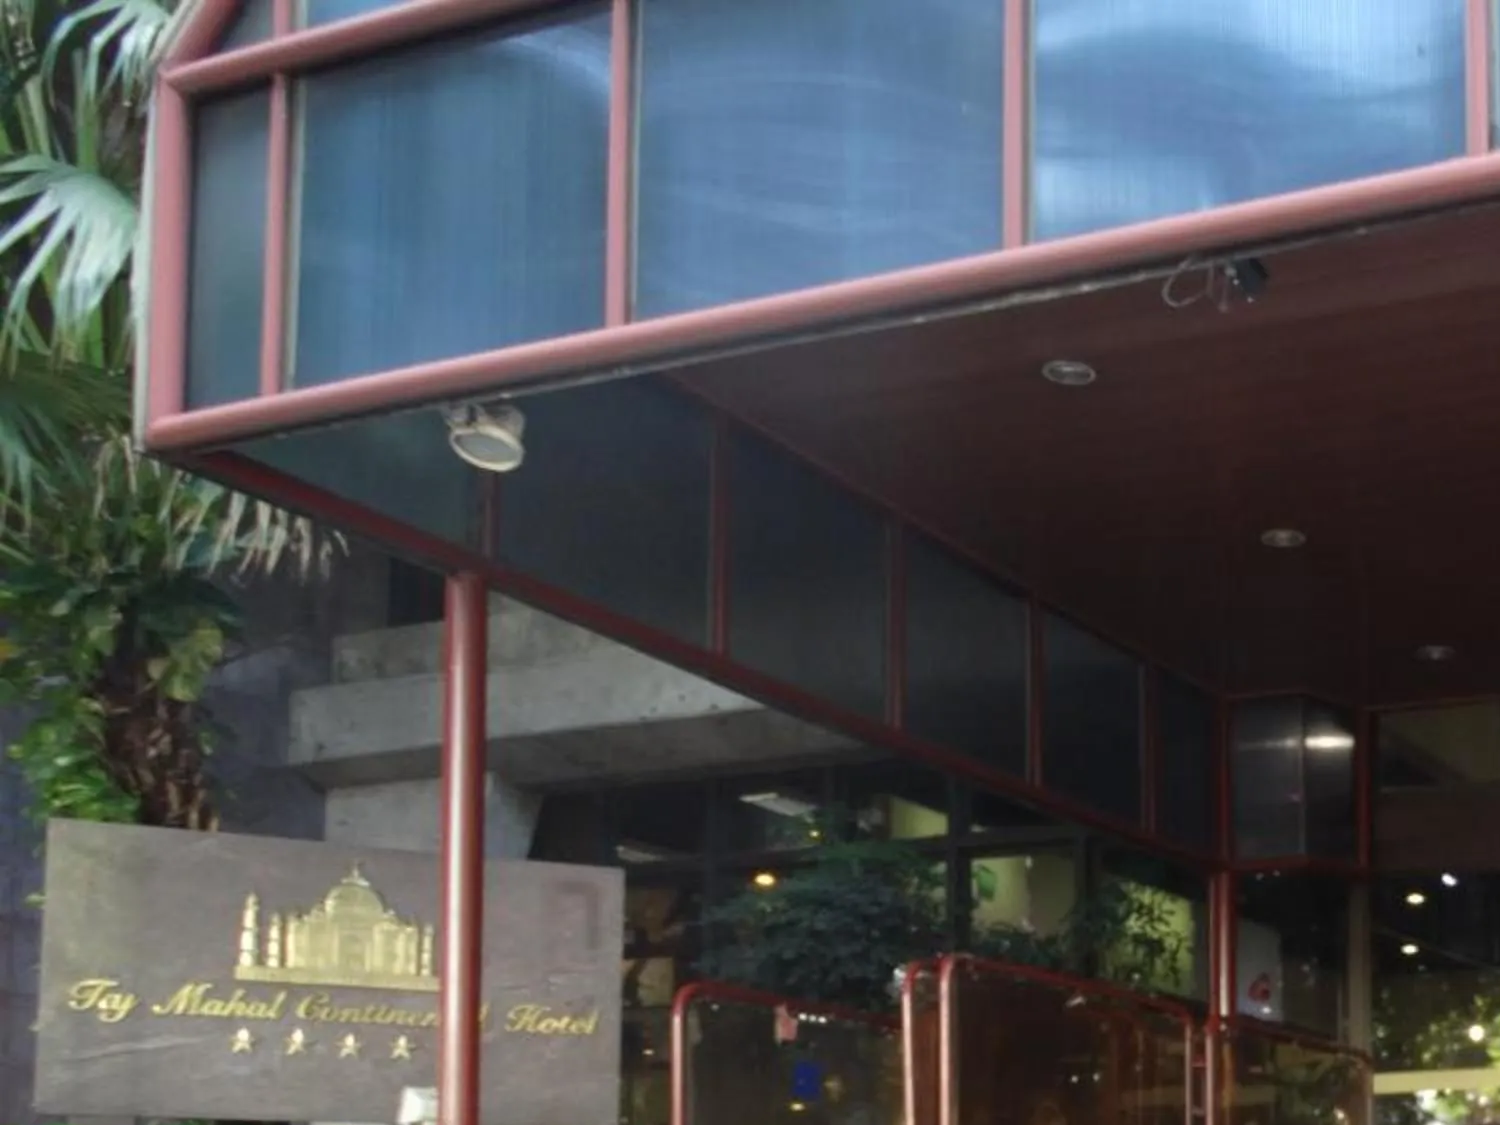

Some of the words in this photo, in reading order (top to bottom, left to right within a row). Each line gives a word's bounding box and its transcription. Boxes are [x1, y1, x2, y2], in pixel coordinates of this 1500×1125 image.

[152, 982, 287, 1020] Mahal
[296, 992, 489, 1031] Continenl
[505, 1003, 598, 1036] Hotel
